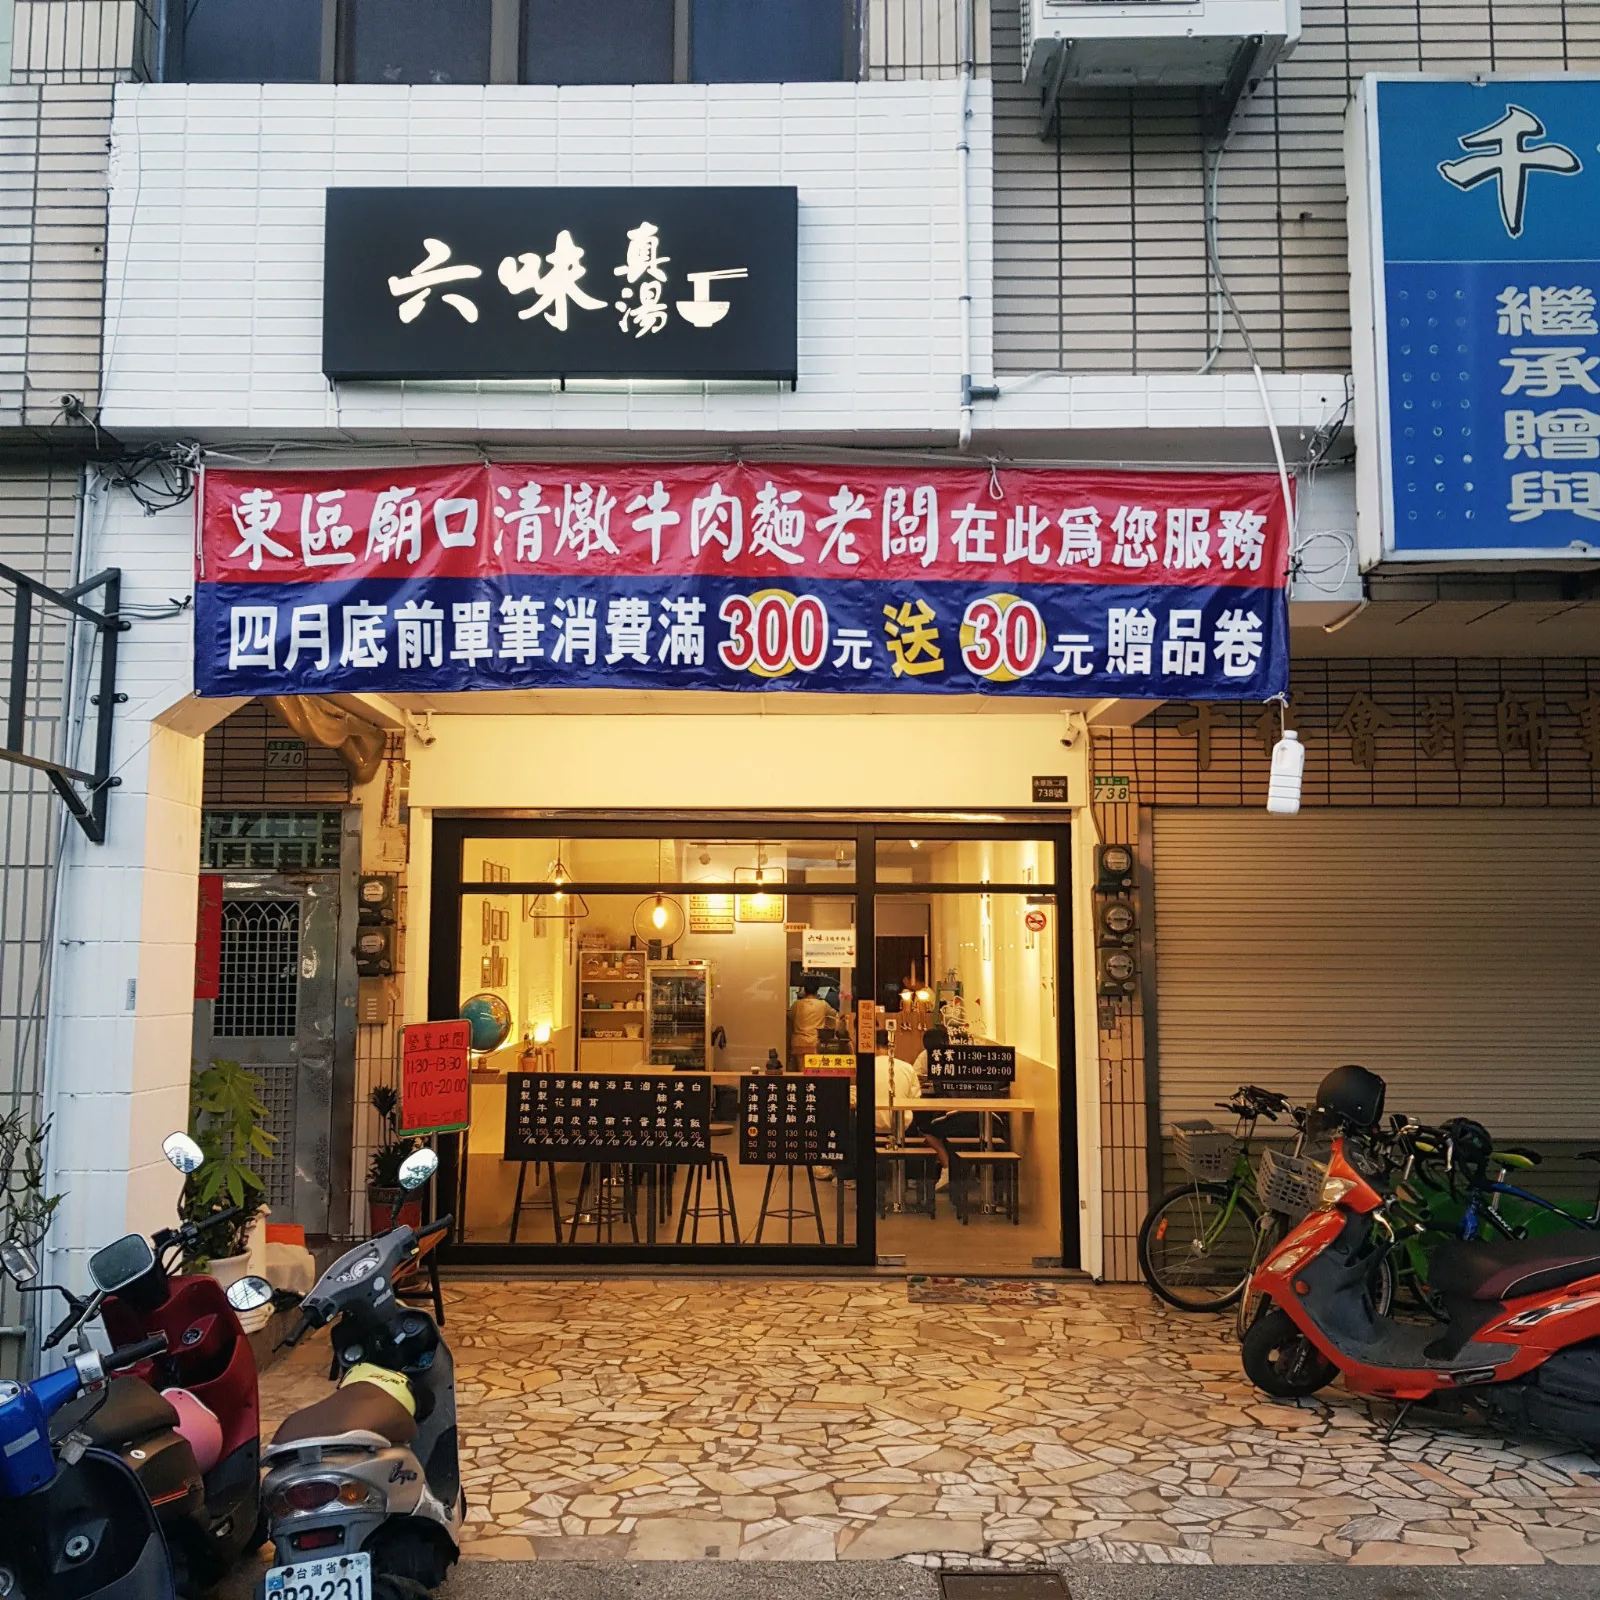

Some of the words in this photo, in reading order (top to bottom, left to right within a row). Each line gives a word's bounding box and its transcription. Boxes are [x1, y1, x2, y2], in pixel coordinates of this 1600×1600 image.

[388, 229, 608, 331] 六味
[613, 221, 671, 338] 真湯
[1496, 285, 1600, 522] 繼承贈與
[270, 752, 302, 764] 740
[1094, 787, 1127, 800] 738
[931, 1049, 955, 1061] 營業
[957, 1051, 1012, 1061] 11:30-13:30
[931, 1063, 955, 1076] 時間
[957, 1064, 1012, 1076] 17:00-20:00
[767, 1129, 777, 1137] 60
[785, 1129, 798, 1137] 130
[804, 1152, 817, 1160] 170
[297, 1561, 338, 1580] 台灣省
